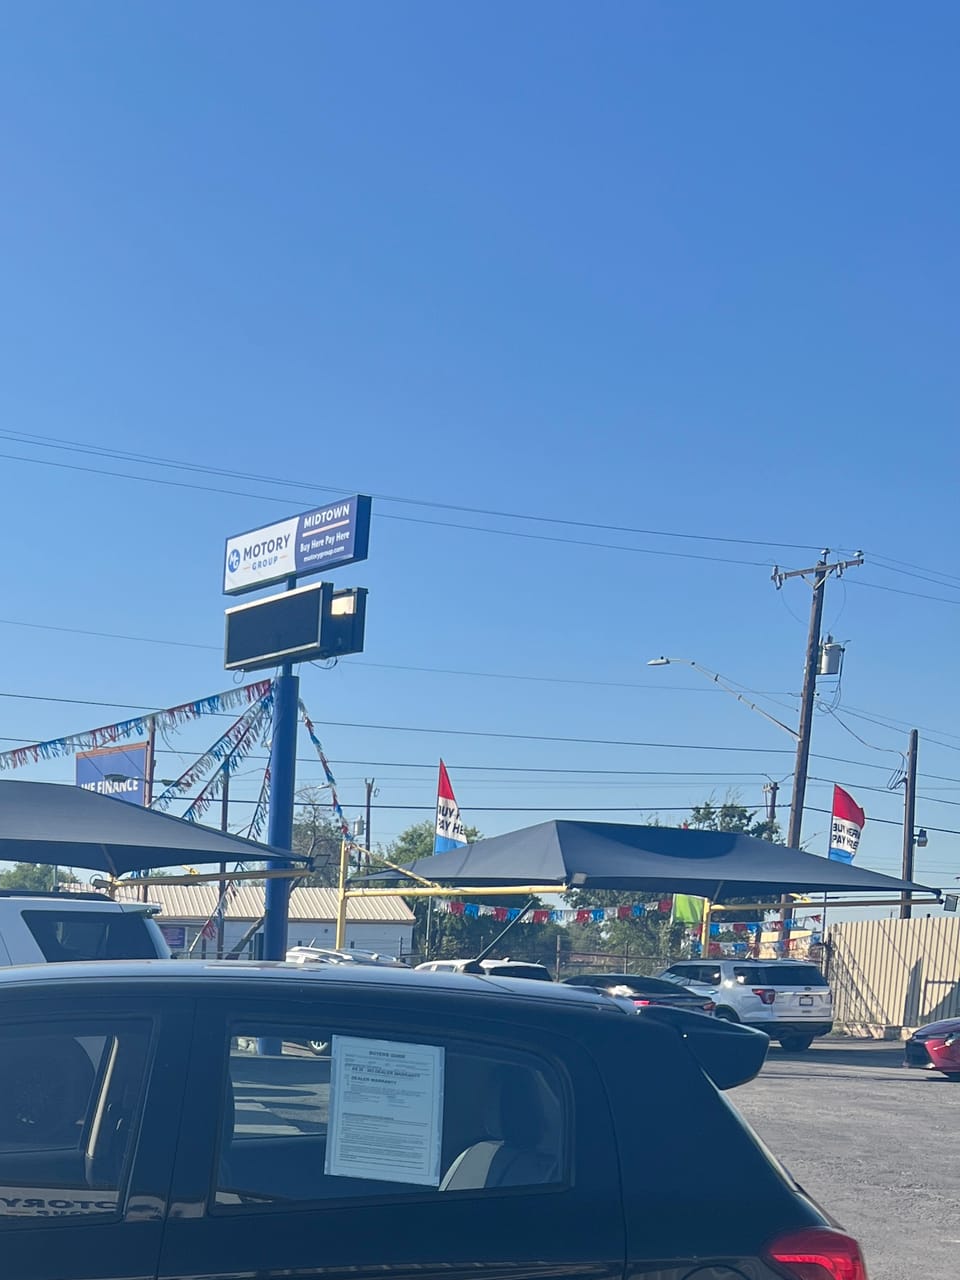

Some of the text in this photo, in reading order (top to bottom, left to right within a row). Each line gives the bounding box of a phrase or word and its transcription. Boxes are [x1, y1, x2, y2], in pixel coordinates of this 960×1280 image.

[304, 504, 350, 528] MIDTOWN
[243, 534, 290, 560] MOTORY
[300, 531, 350, 553] Buy Here Pay Here
[251, 556, 278, 570] GROUP
[97, 779, 139, 794] FINANCE
